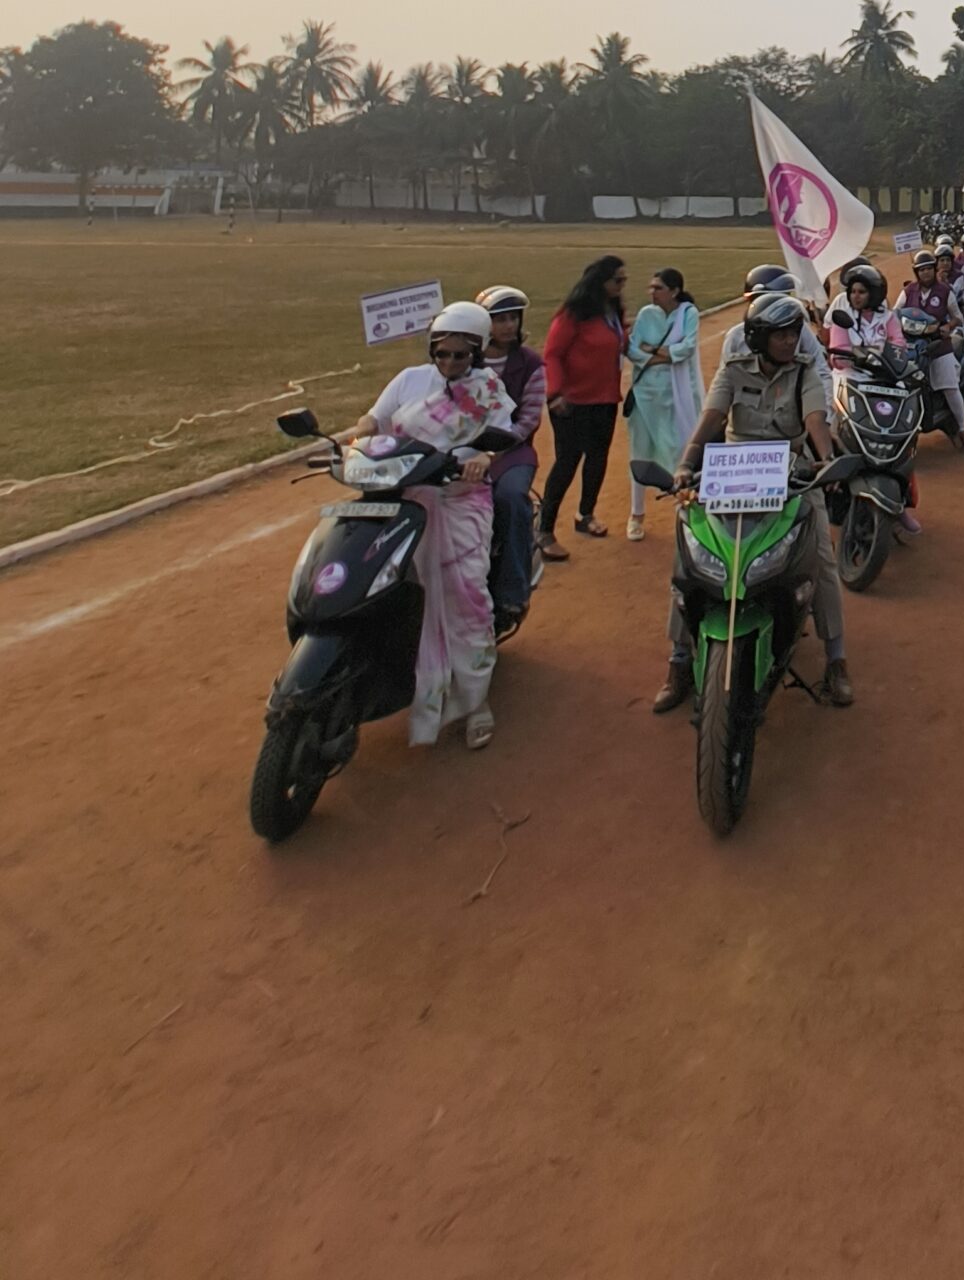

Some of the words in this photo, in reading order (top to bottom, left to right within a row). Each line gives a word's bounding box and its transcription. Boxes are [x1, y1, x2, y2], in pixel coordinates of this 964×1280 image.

[709, 454, 727, 466] LIFE
[729, 454, 738, 466] IS
[739, 454, 744, 464] A
[746, 452, 784, 464] JOURNEY
